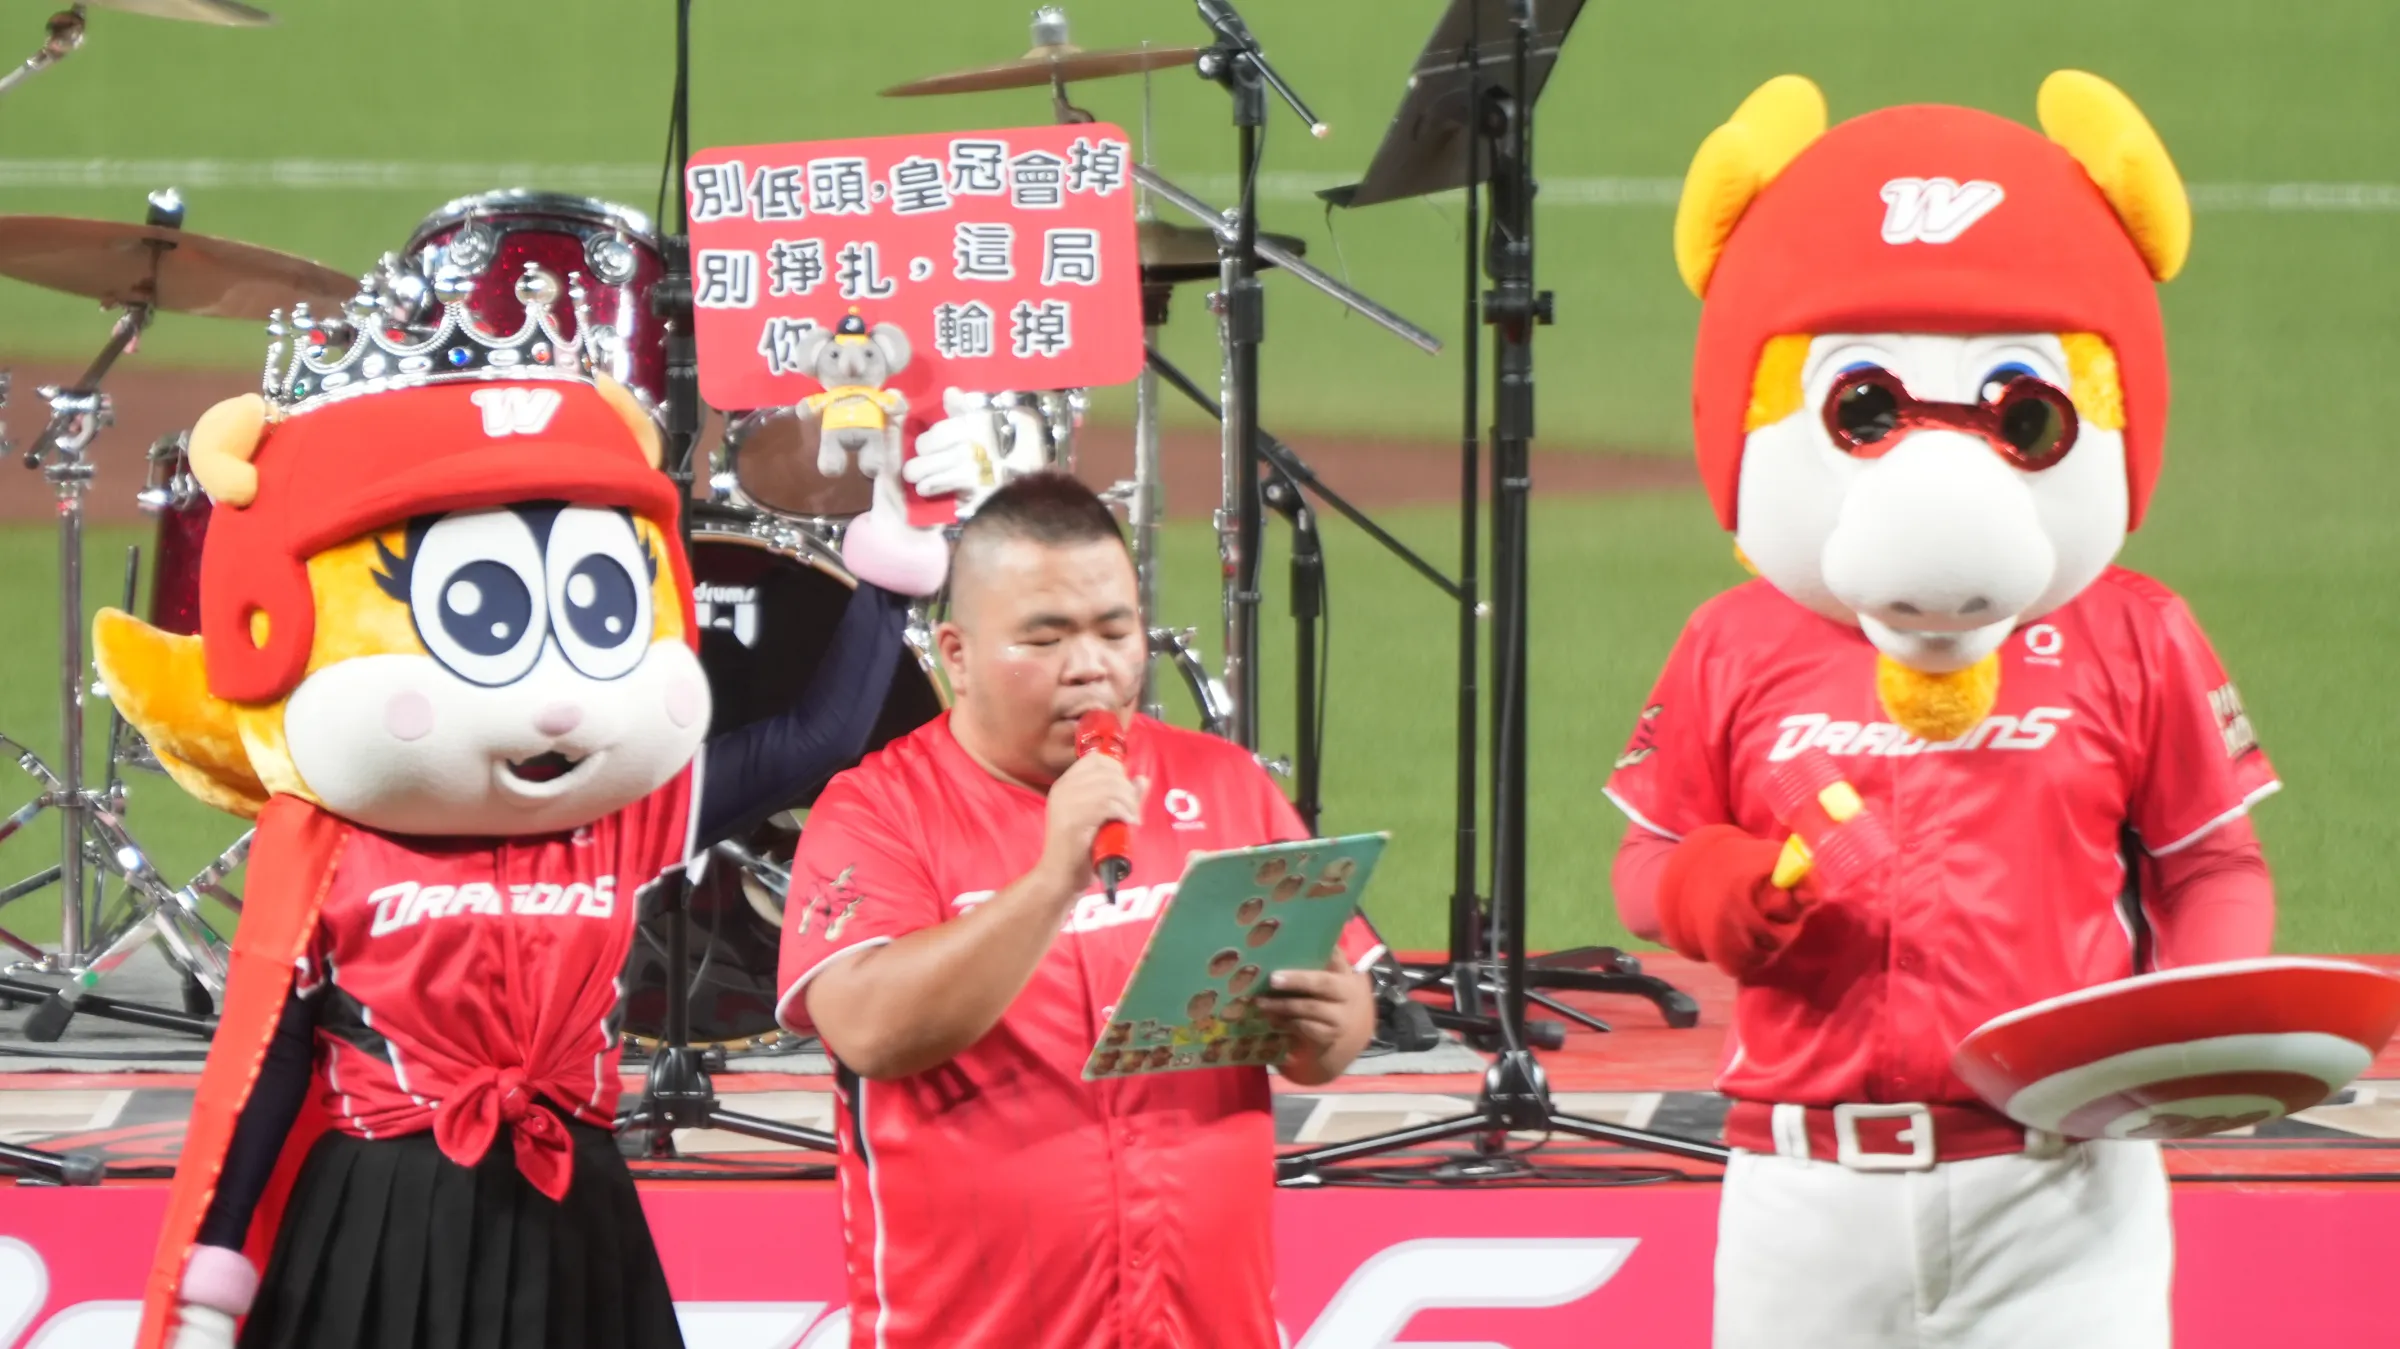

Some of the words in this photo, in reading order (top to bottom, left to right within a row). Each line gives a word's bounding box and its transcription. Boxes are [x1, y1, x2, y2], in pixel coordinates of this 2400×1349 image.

[1880, 177, 2005, 245] W
[761, 300, 1070, 376] 你輸掉
[470, 386, 562, 438] W
[1767, 706, 2074, 761] DRANS
